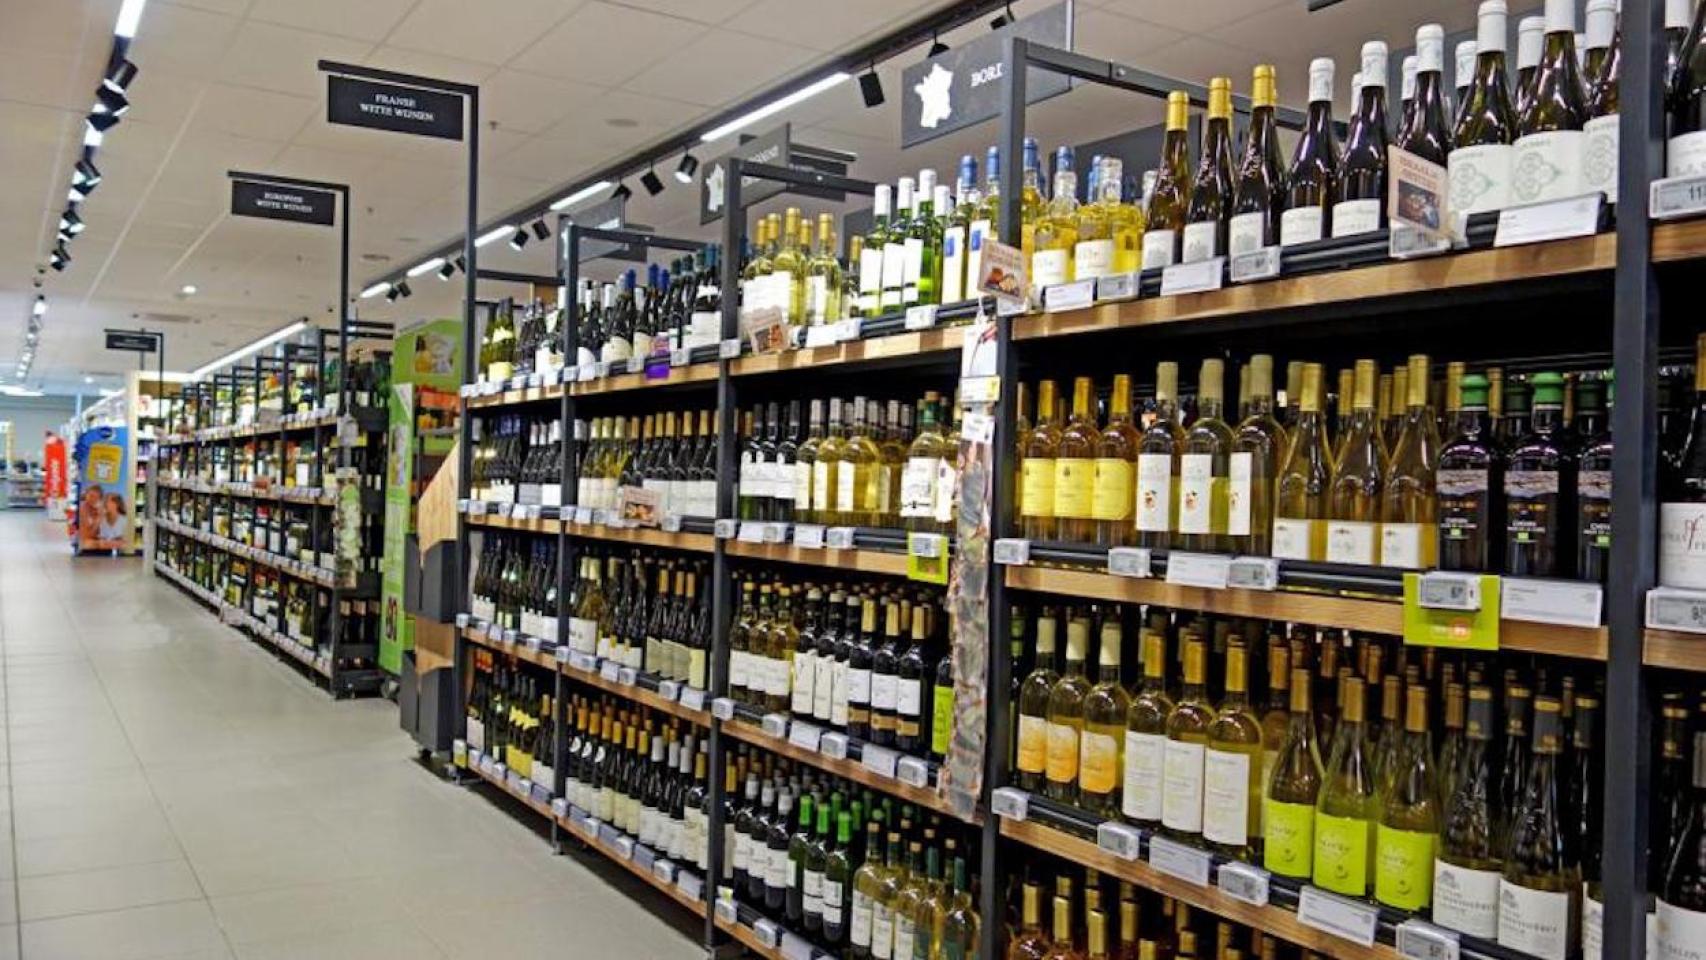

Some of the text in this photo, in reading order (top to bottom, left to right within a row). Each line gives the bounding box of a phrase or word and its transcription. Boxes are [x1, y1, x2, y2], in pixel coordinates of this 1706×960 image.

[375, 94, 416, 108] FRANSE
[360, 104, 434, 122] WITTE WIJNEN
[1689, 184, 1705, 200] 11
